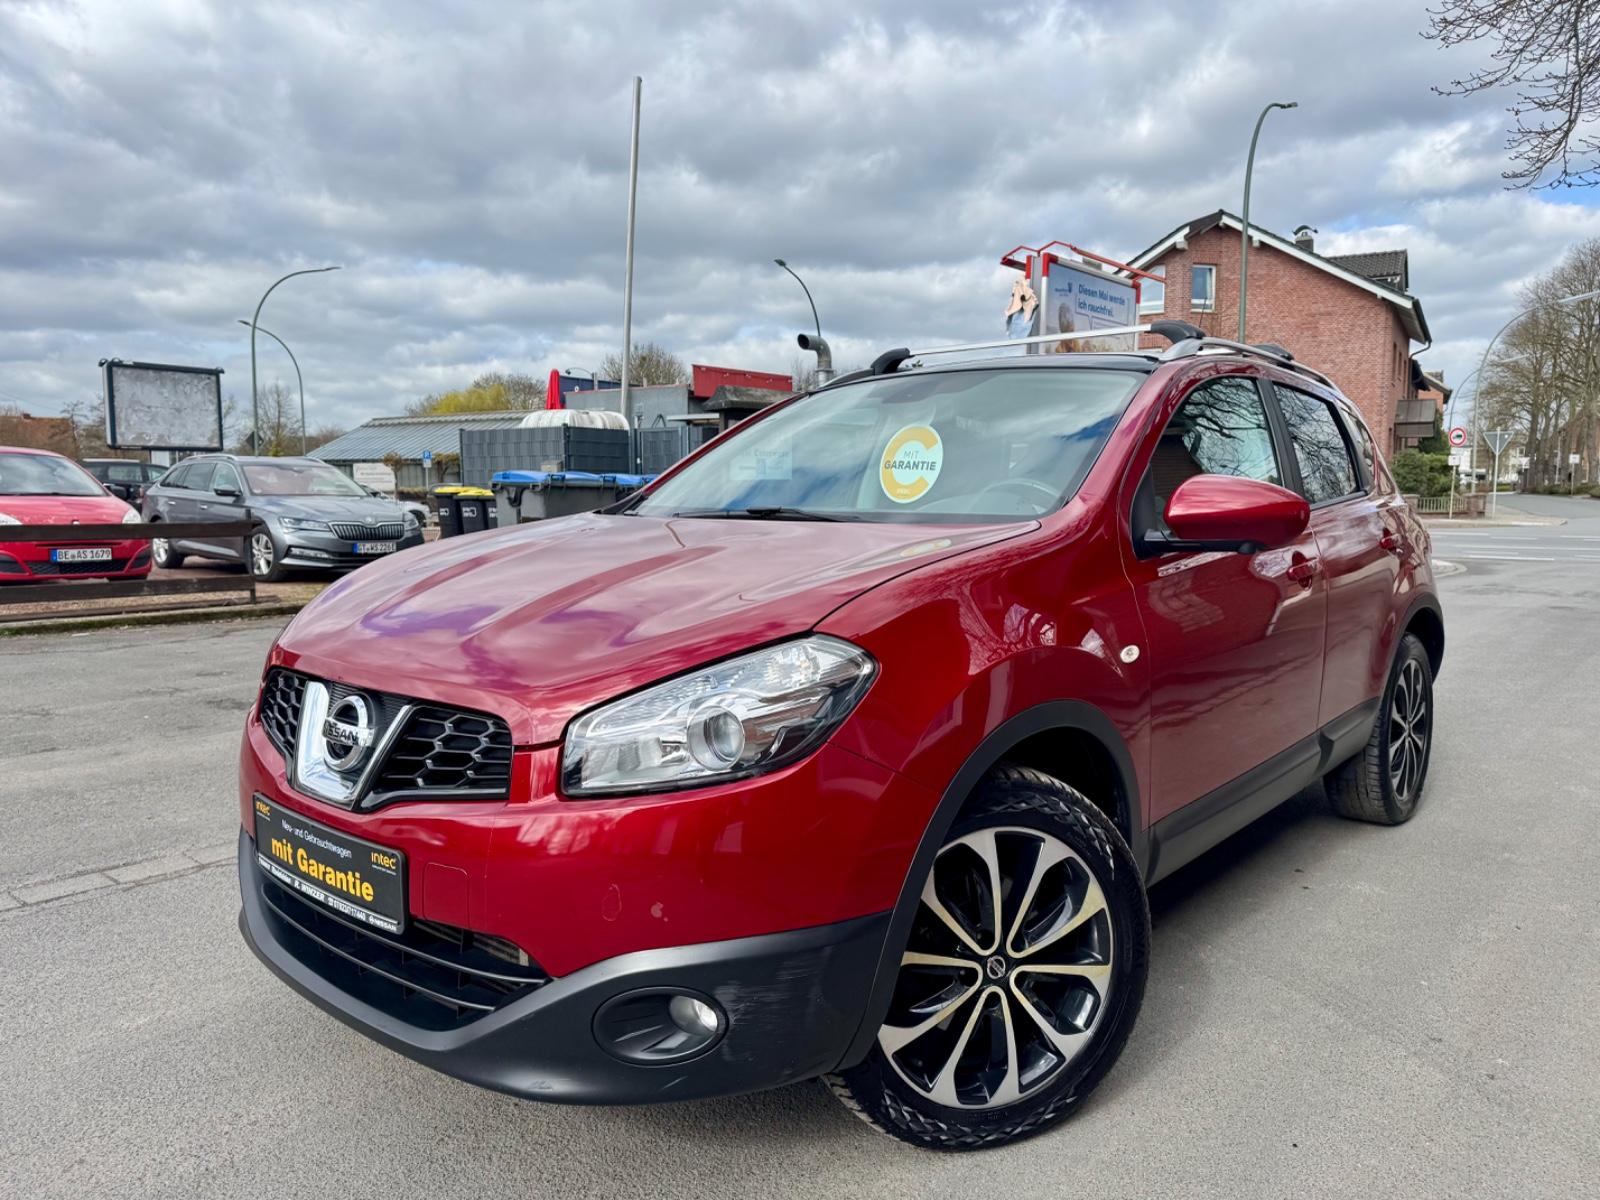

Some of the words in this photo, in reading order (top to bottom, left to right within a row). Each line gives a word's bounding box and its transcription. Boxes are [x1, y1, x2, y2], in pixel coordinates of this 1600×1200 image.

[1078, 283, 1098, 298] Diesen
[1078, 298, 1088, 311] ich
[903, 450, 921, 460] MIT
[884, 460, 938, 471] GARANTIE
[57, 551, 70, 560] BE
[76, 550, 88, 559] AS
[90, 549, 111, 559] 1679
[323, 720, 359, 745] NISSAN
[271, 838, 294, 866] mit
[296, 847, 374, 902] Garantie
